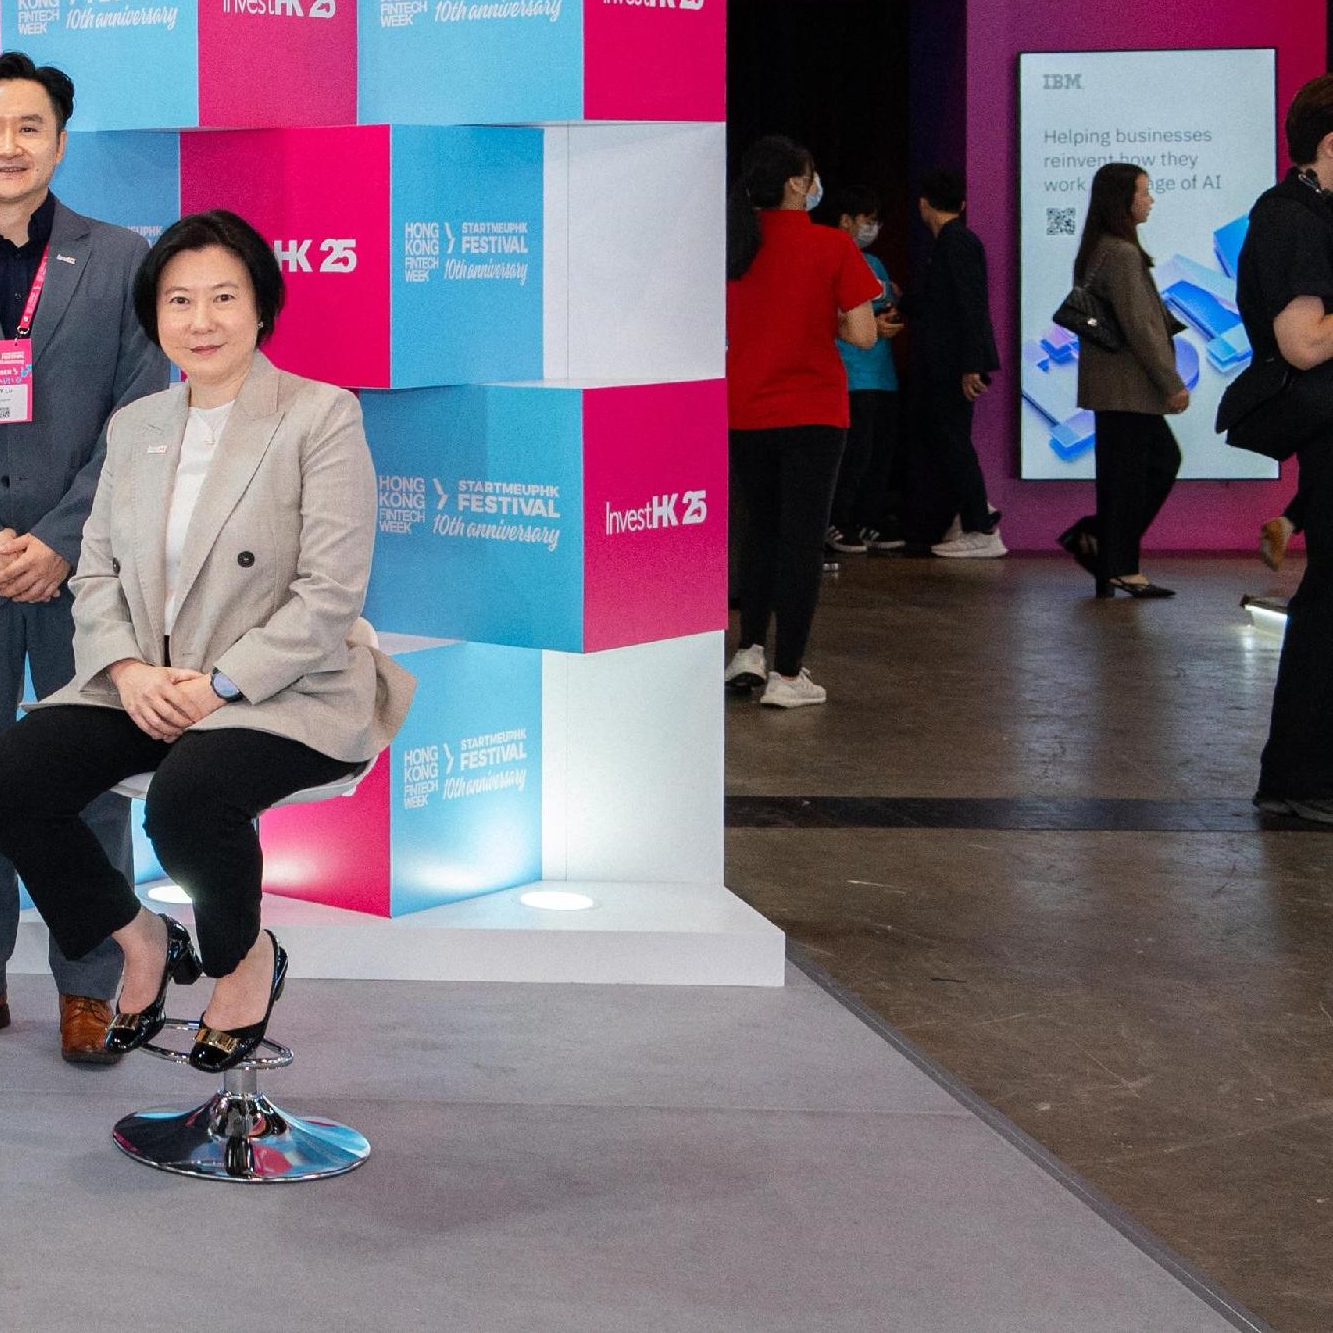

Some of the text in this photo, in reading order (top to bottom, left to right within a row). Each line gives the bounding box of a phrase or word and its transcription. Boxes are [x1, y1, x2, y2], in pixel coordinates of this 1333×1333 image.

[1042, 73, 1083, 90] IBM
[1043, 128, 1213, 147] Helping businesses
[1043, 153, 1115, 168] reinvent
[1160, 152, 1199, 169] they
[1044, 177, 1085, 192] work
[1180, 175, 1197, 191] of
[1202, 175, 1222, 190] AI
[320, 238, 357, 273] 25
[380, 476, 425, 492] HONG
[379, 493, 424, 509] KONG
[459, 494, 560, 517] FESTIVAL
[606, 490, 706, 535] InvestHK 25
